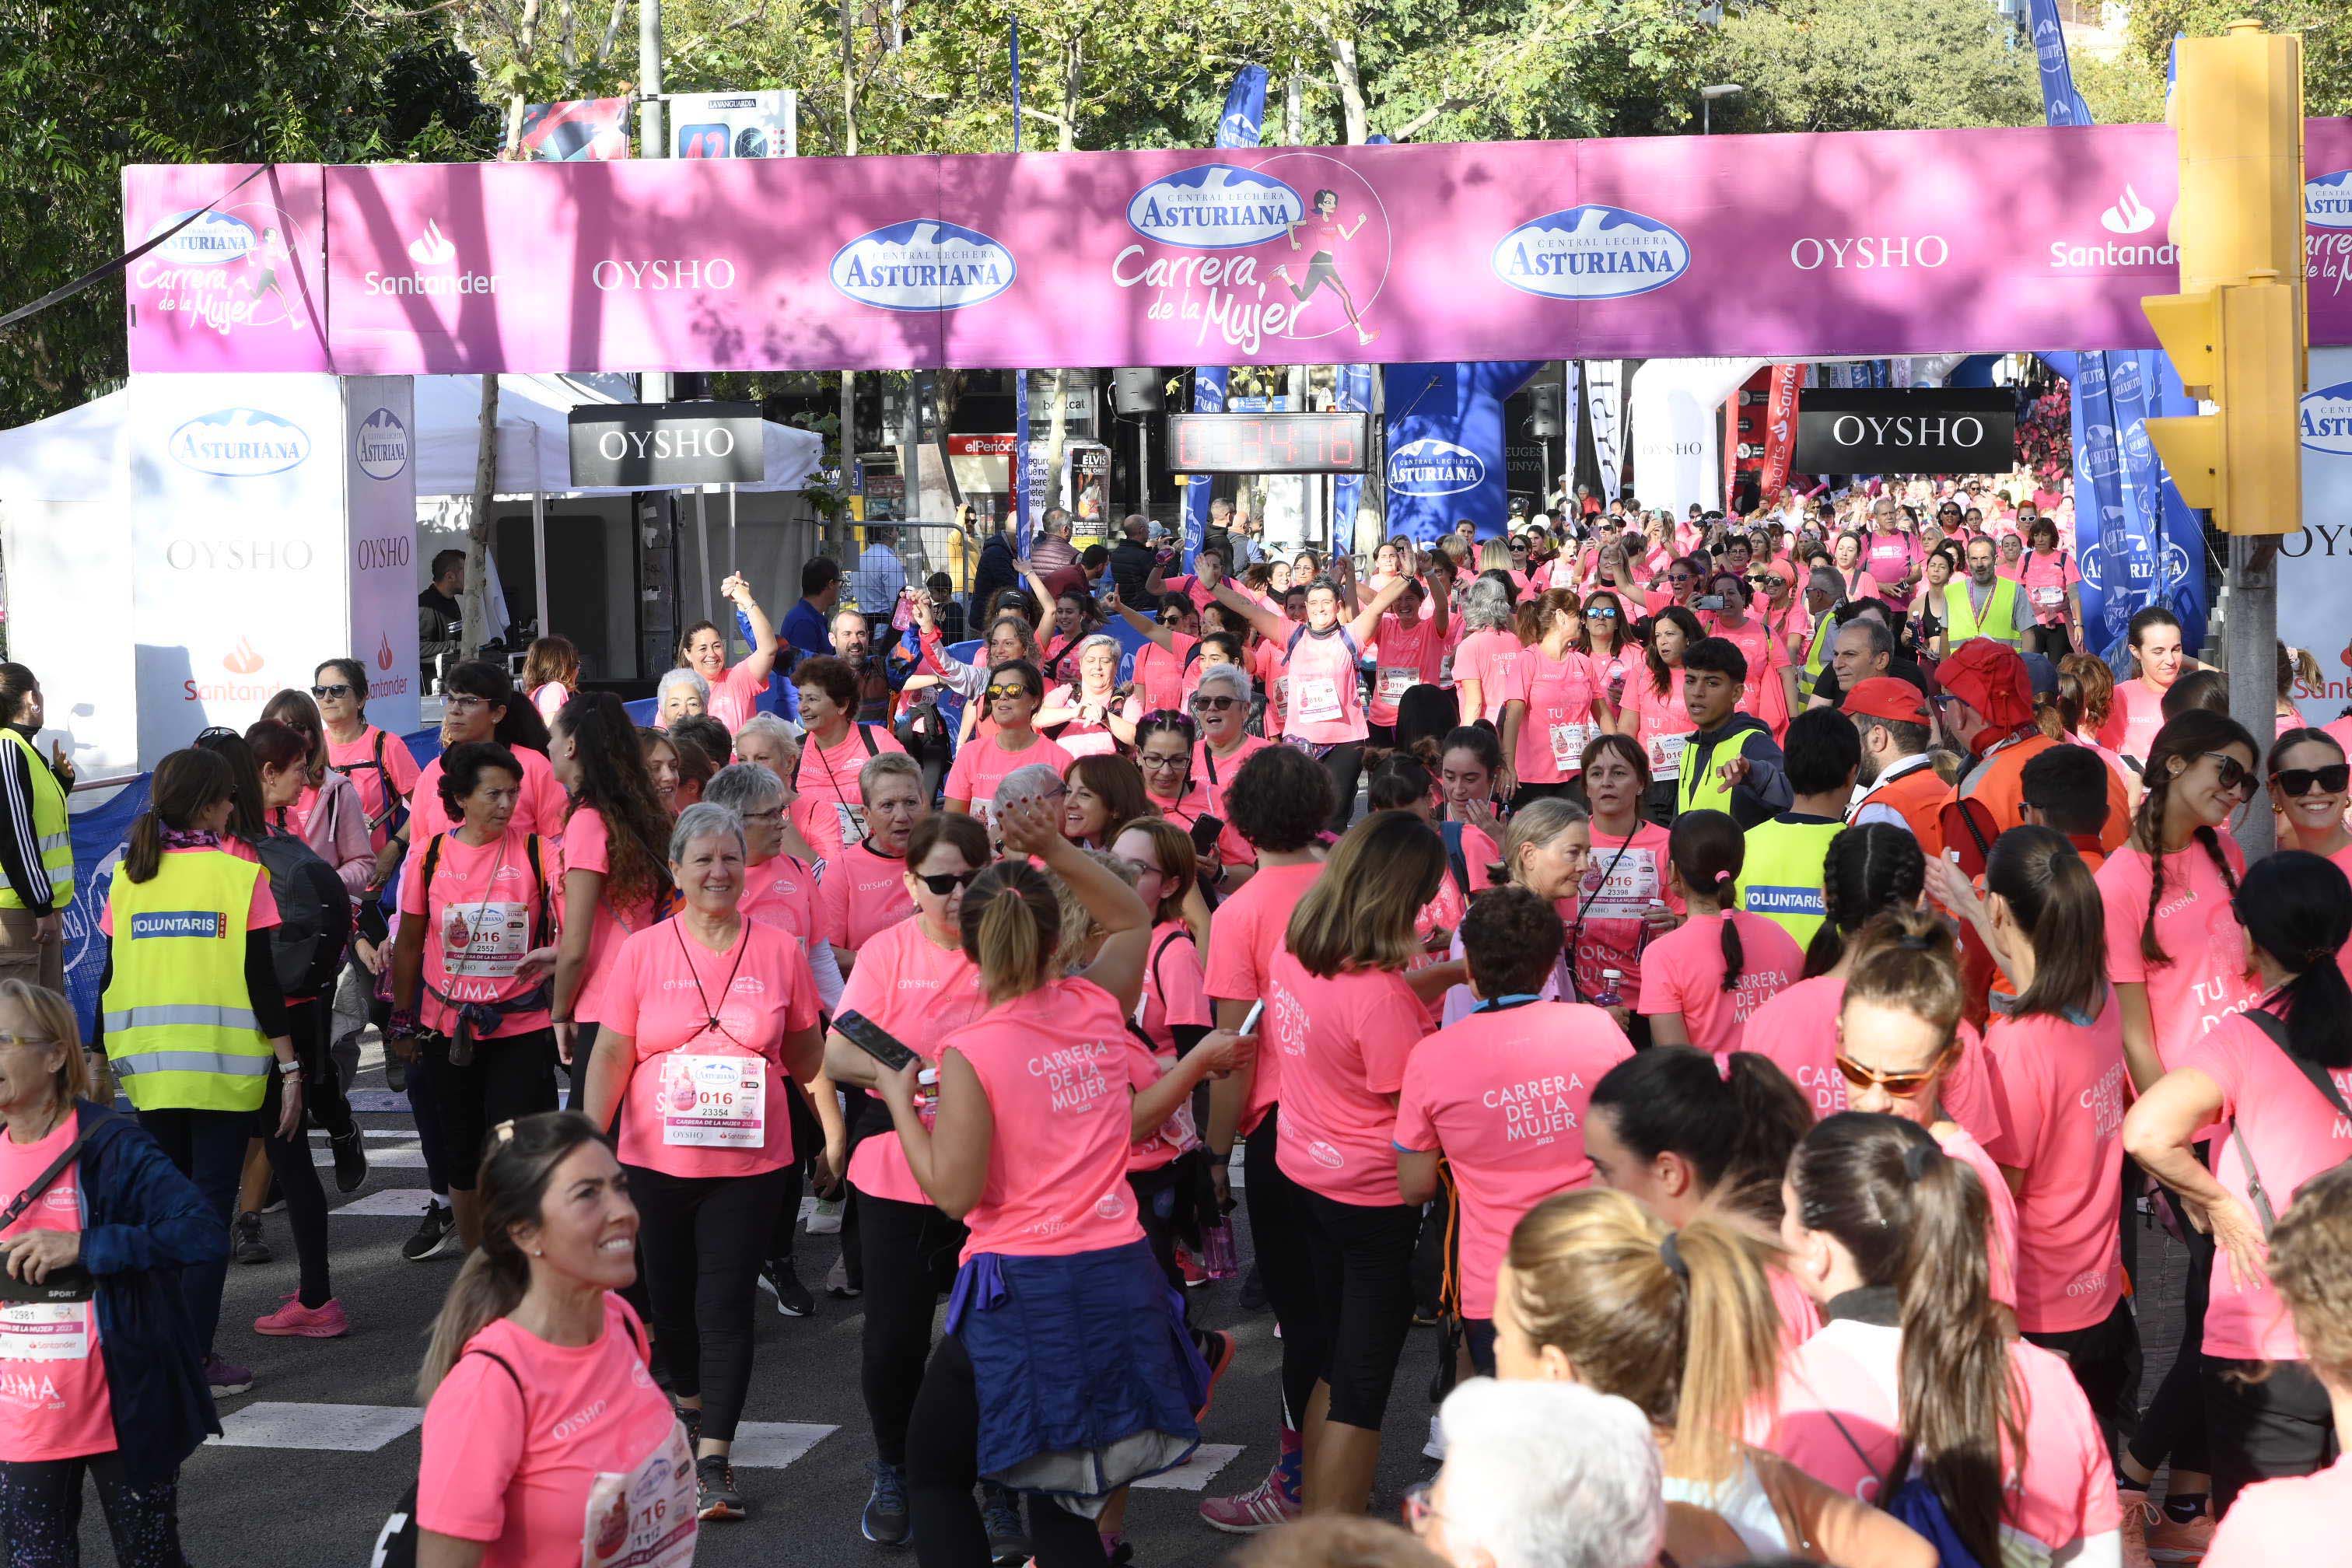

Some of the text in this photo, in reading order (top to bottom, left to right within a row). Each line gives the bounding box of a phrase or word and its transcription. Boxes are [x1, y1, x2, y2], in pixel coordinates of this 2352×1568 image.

[1167, 192, 1284, 202] CENTRAL LECHERA
[1140, 196, 1290, 227] ASTURIANA
[873, 249, 995, 260] CENTRAL LECHERA
[1538, 236, 1668, 248] CENTRAL LECHERA
[1790, 235, 1948, 270] OYSHO
[2050, 241, 2179, 268] Santand
[844, 254, 1003, 287] ASTURIANA
[1111, 244, 1258, 288] Carrera
[1509, 241, 1675, 275] ASTURIANA
[135, 261, 228, 289] Carrera
[365, 271, 500, 296] Santander
[593, 258, 735, 291] OYSHO
[159, 286, 262, 335] de la Mujer
[1148, 282, 1312, 355] de la Mujer
[599, 427, 734, 460] OYSHO
[1833, 415, 1983, 447] OYSHO
[180, 433, 301, 459] ASTURIANA
[360, 434, 405, 463] ASTURIANA
[1506, 446, 1543, 457] EUGES
[1083, 455, 1108, 464] ELVIS
[1507, 462, 1542, 471] UNYA
[1390, 463, 1478, 484] ASTURIANA
[166, 540, 313, 570] OYSHO
[358, 536, 410, 571] OYSHO
[1548, 709, 1563, 719] TU
[1648, 718, 1660, 729] TU
[859, 879, 893, 891] OYSHO
[1606, 877, 1633, 887] 016
[2159, 891, 2198, 919] OYSHO
[133, 918, 215, 933] VOLUNTARIS
[473, 932, 500, 943] 016
[441, 979, 499, 1000] SUMA
[898, 978, 940, 990] OYSHO
[1727, 971, 1788, 994] ARRERA
[2192, 976, 2224, 1006] TU
[1736, 991, 1755, 1009] DE
[1027, 1039, 1108, 1077] CARRERA
[1049, 1061, 1100, 1091] DE LA
[2080, 1061, 2123, 1109] CARRER
[700, 1092, 733, 1104] 016
[1052, 1076, 1108, 1111] MUJER
[1483, 1073, 1584, 1108] CARRERA
[1816, 1089, 1846, 1111] DE
[702, 1108, 728, 1117] 23354
[1506, 1095, 1570, 1122] DE LA
[673, 1131, 703, 1139] OYSHO
[1507, 1112, 1578, 1142] MUJER
[10, 1310, 35, 1320] 12981
[37, 1339, 76, 1349] Santander
[552, 1398, 607, 1441] OYSHO
